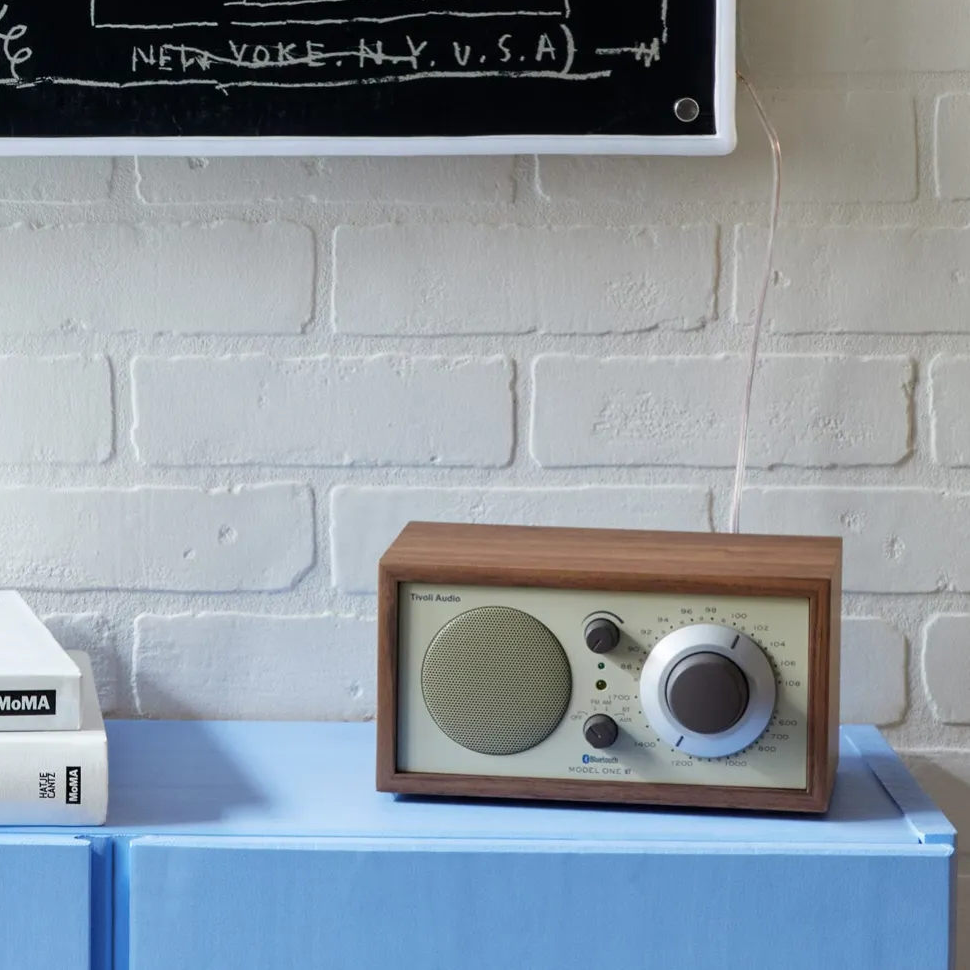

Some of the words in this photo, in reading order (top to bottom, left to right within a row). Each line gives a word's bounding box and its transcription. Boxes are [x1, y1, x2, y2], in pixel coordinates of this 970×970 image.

[410, 593, 434, 602] Tivoli
[435, 594, 461, 602] Audio
[590, 756, 618, 764] Bluetooth
[39, 772, 48, 798] HATJE
[47, 773, 56, 798] CANTZ
[69, 769, 78, 802] MoMA
